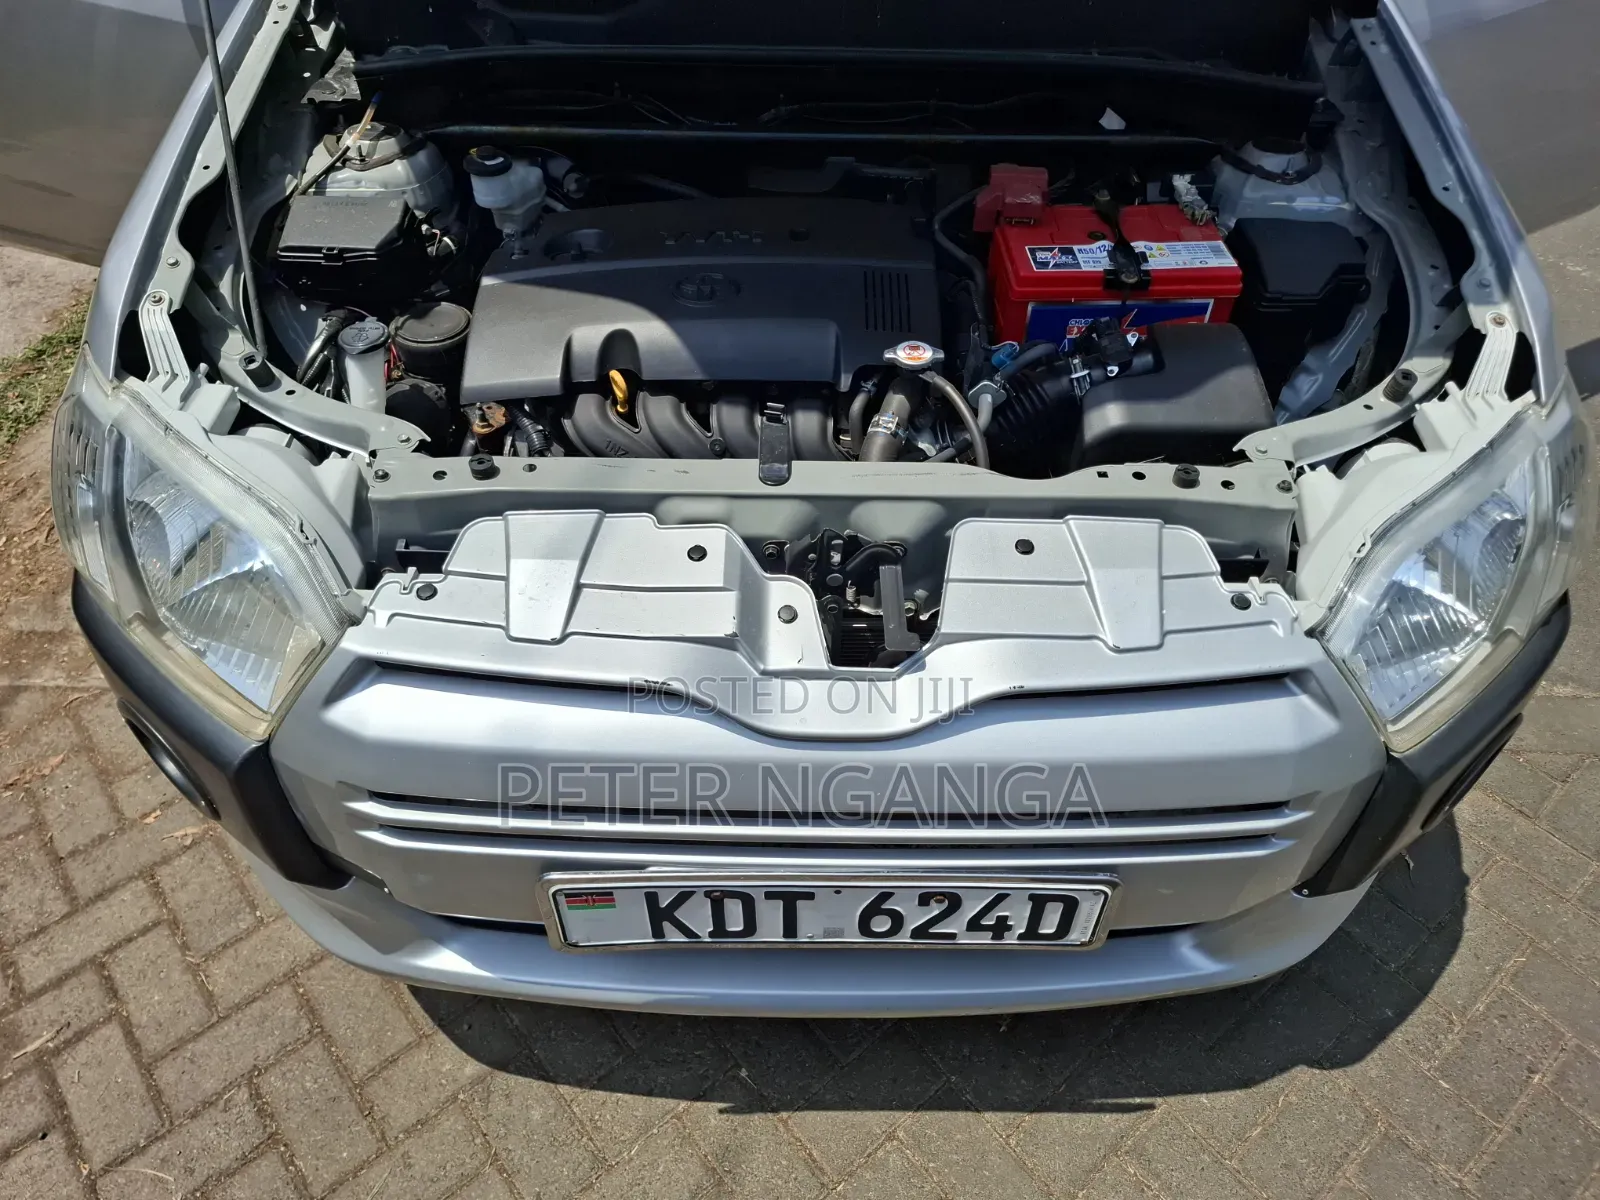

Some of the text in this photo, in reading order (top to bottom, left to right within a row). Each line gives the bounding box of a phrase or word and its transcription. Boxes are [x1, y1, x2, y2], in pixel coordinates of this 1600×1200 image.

[1068, 318, 1093, 327] CHLO
[644, 889, 816, 940] KDT
[857, 890, 1081, 942] 624D
